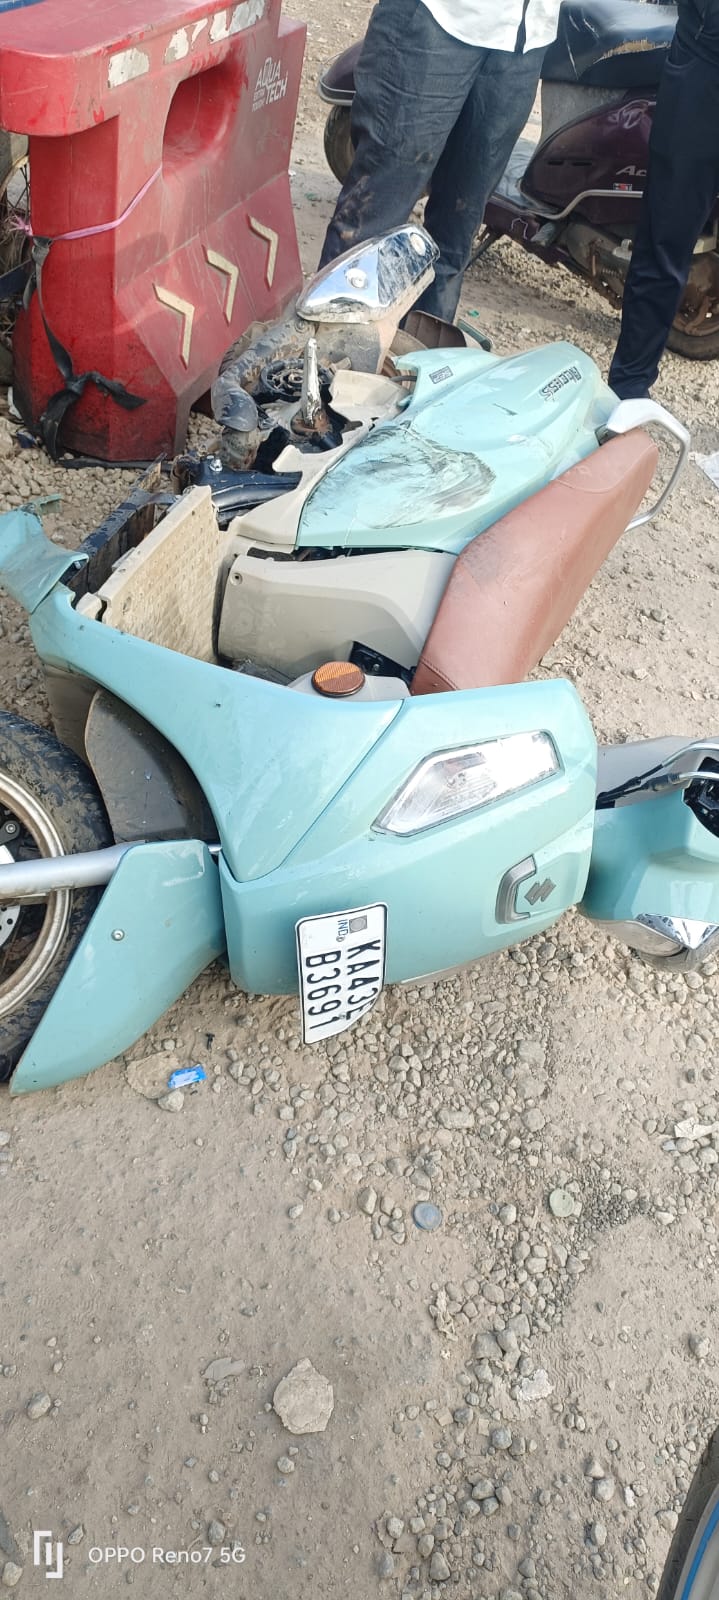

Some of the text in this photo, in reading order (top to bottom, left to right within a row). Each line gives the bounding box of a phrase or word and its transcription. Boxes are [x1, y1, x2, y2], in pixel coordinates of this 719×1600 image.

[255, 57, 281, 91] AQUA
[266, 70, 288, 104] TECH
[337, 919, 349, 936] IND
[306, 950, 342, 1029] B3691
